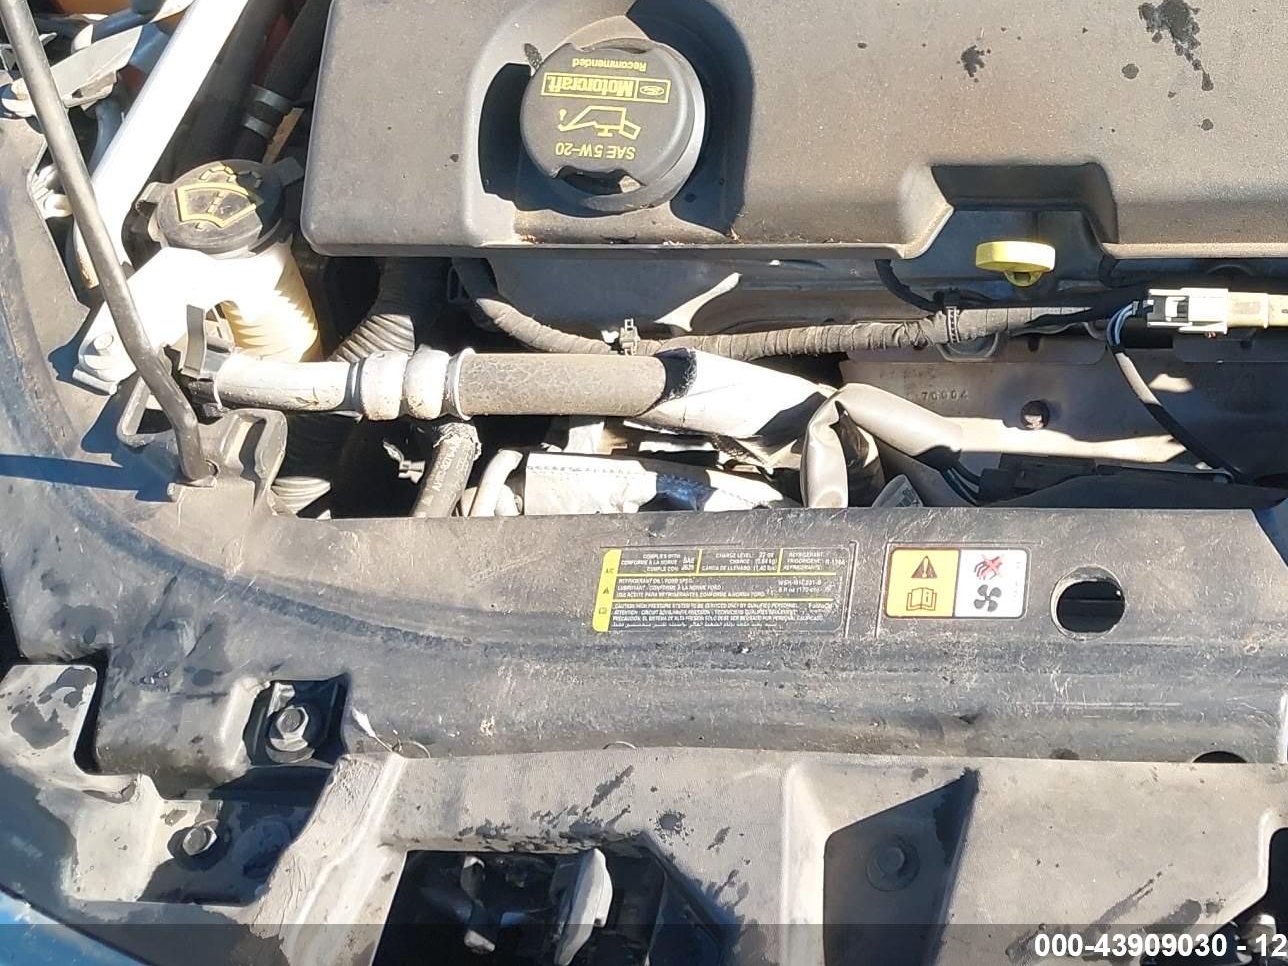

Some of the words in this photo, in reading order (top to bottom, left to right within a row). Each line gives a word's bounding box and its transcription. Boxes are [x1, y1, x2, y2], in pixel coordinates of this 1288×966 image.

[572, 58, 647, 72] Recommended
[547, 76, 634, 98] Motorcraft
[607, 145, 636, 160] SAE
